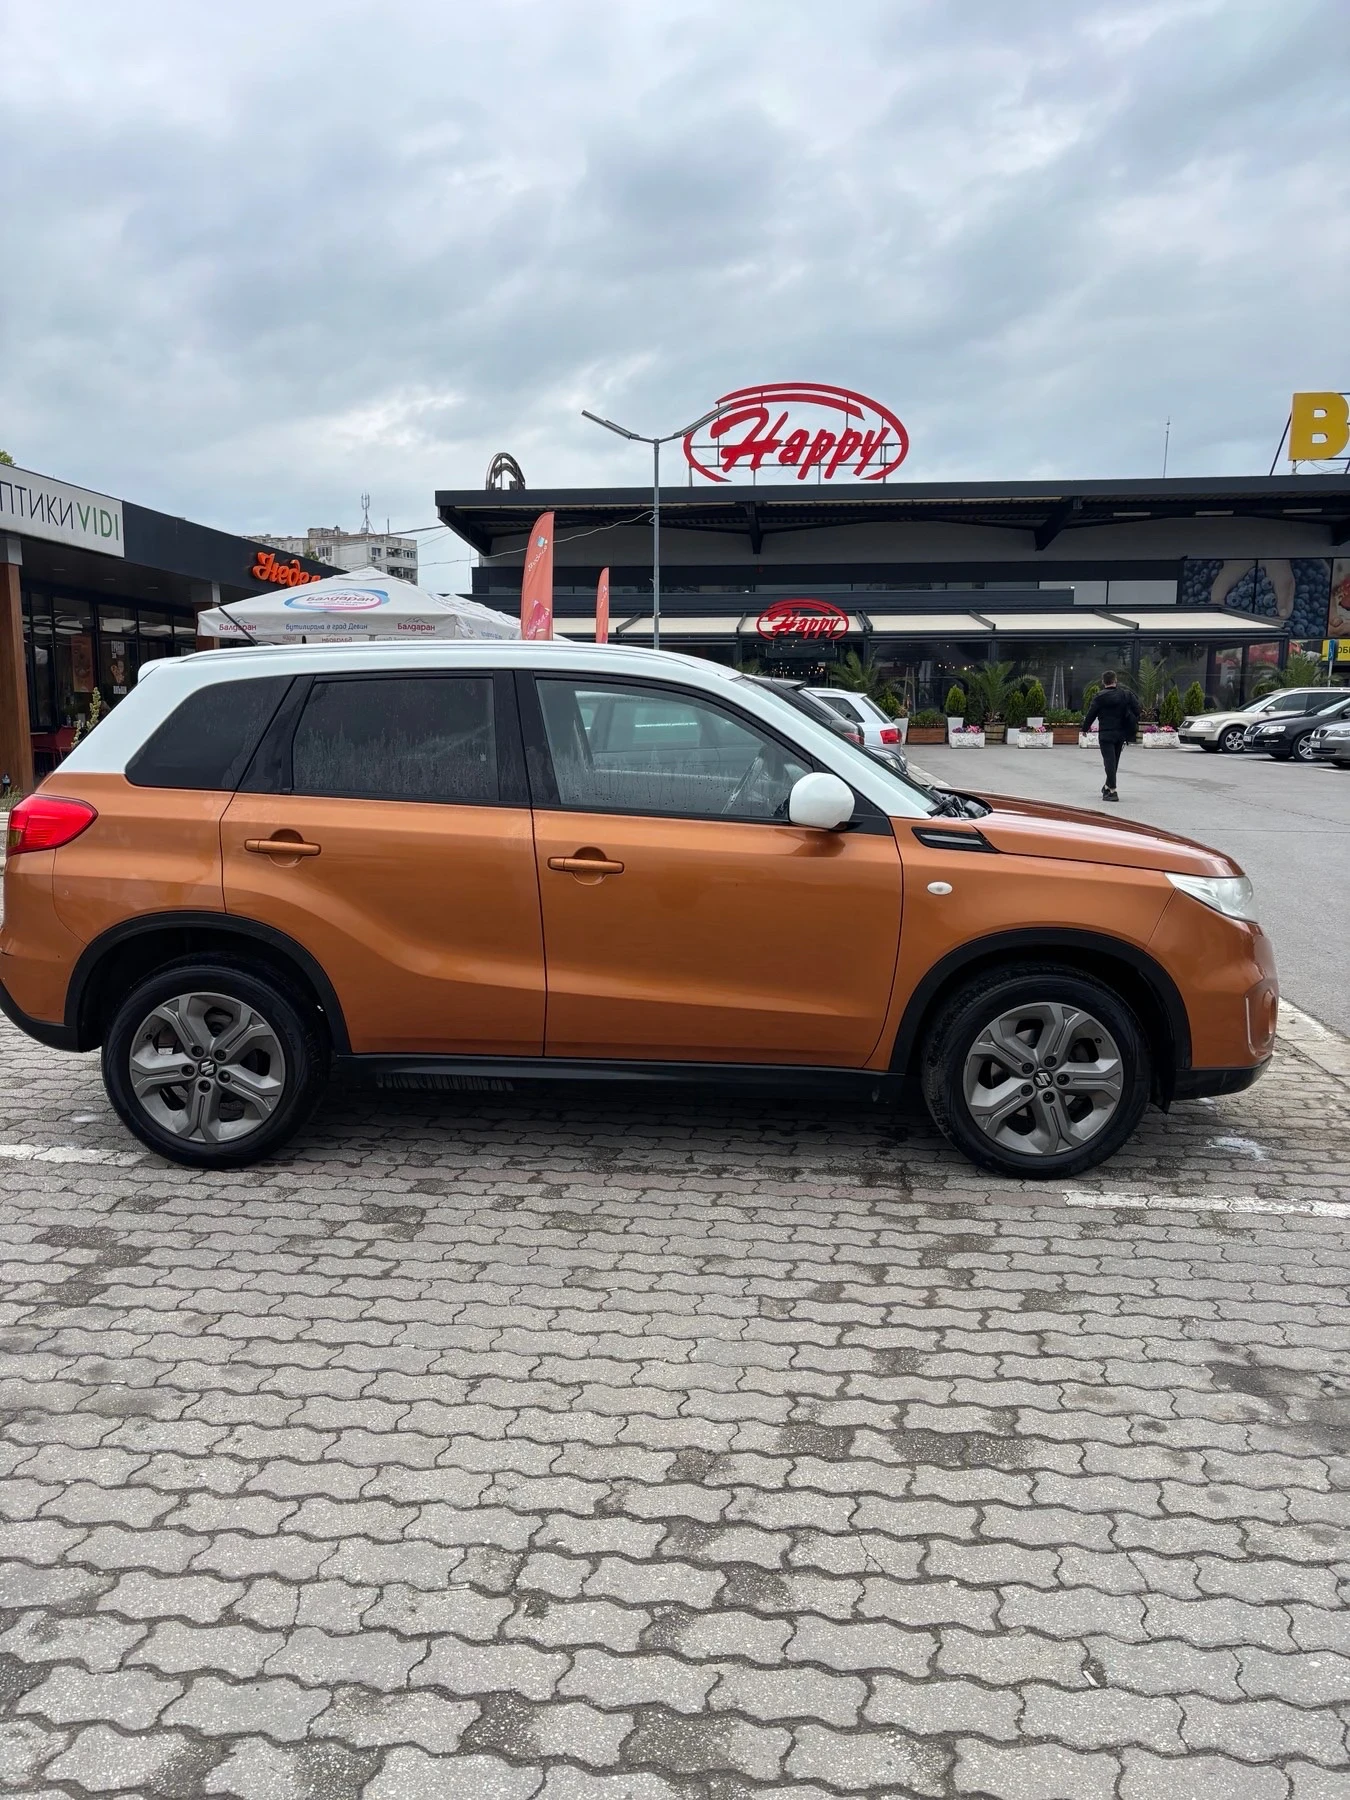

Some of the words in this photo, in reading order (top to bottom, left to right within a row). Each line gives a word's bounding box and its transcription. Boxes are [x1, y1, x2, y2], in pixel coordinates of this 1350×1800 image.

[710, 407, 890, 480] Happy
[76, 502, 119, 541] VIDI
[219, 623, 257, 632] Балдран
[397, 622, 436, 632] Балдаран
[768, 609, 841, 639] Happy
